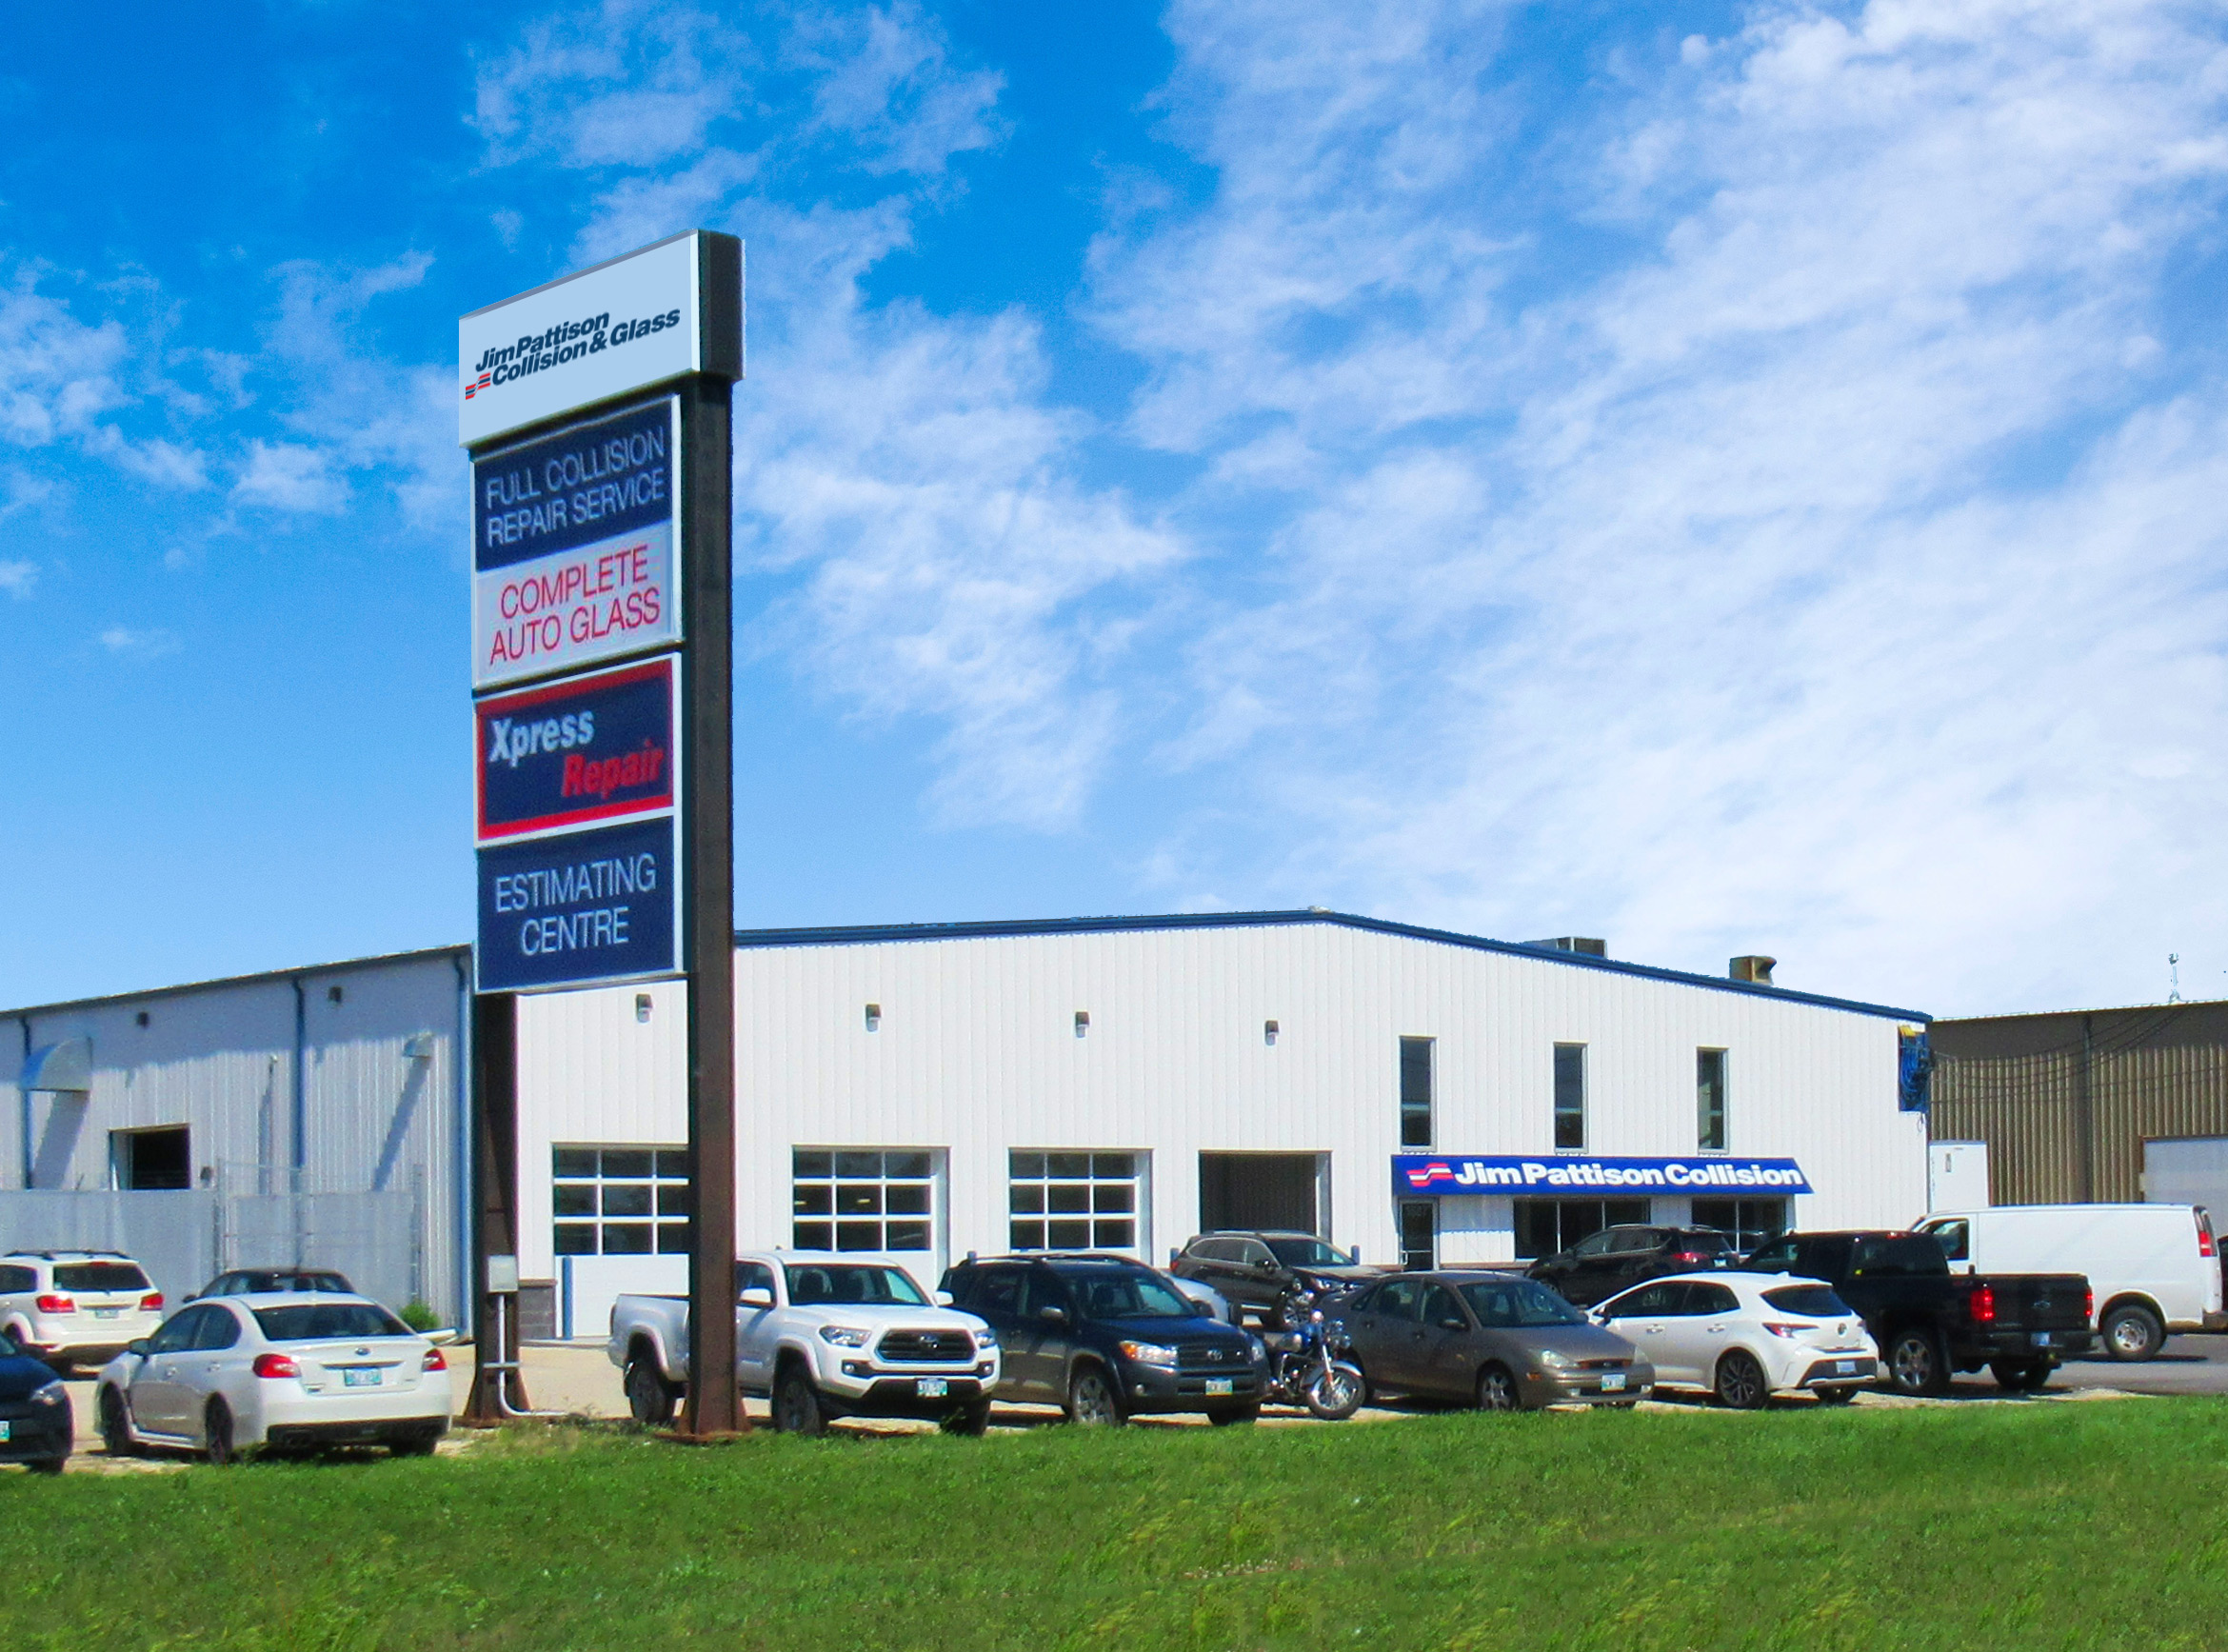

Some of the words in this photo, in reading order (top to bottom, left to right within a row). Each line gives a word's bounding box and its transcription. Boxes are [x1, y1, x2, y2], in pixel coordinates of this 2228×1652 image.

[475, 344, 515, 372] Jim
[515, 311, 610, 359] Pattison
[492, 341, 587, 386] Collision
[588, 330, 607, 354] &
[610, 309, 681, 347] Glass
[486, 468, 541, 509] FULL
[546, 426, 665, 492] COLLISION
[487, 499, 567, 547] REPAIR
[573, 468, 665, 524] SERVICE
[501, 545, 648, 619] COMPLETE
[489, 615, 561, 666] AUTO
[570, 587, 660, 643] GLASS
[488, 710, 595, 767] Xpress
[561, 738, 665, 800] Repair
[496, 853, 657, 913] ESTIMATING
[521, 906, 629, 956] CENTRE
[1455, 1162, 1522, 1184] Jim
[1522, 1163, 1665, 1185] Pattison
[1665, 1164, 1803, 1185] Collision
